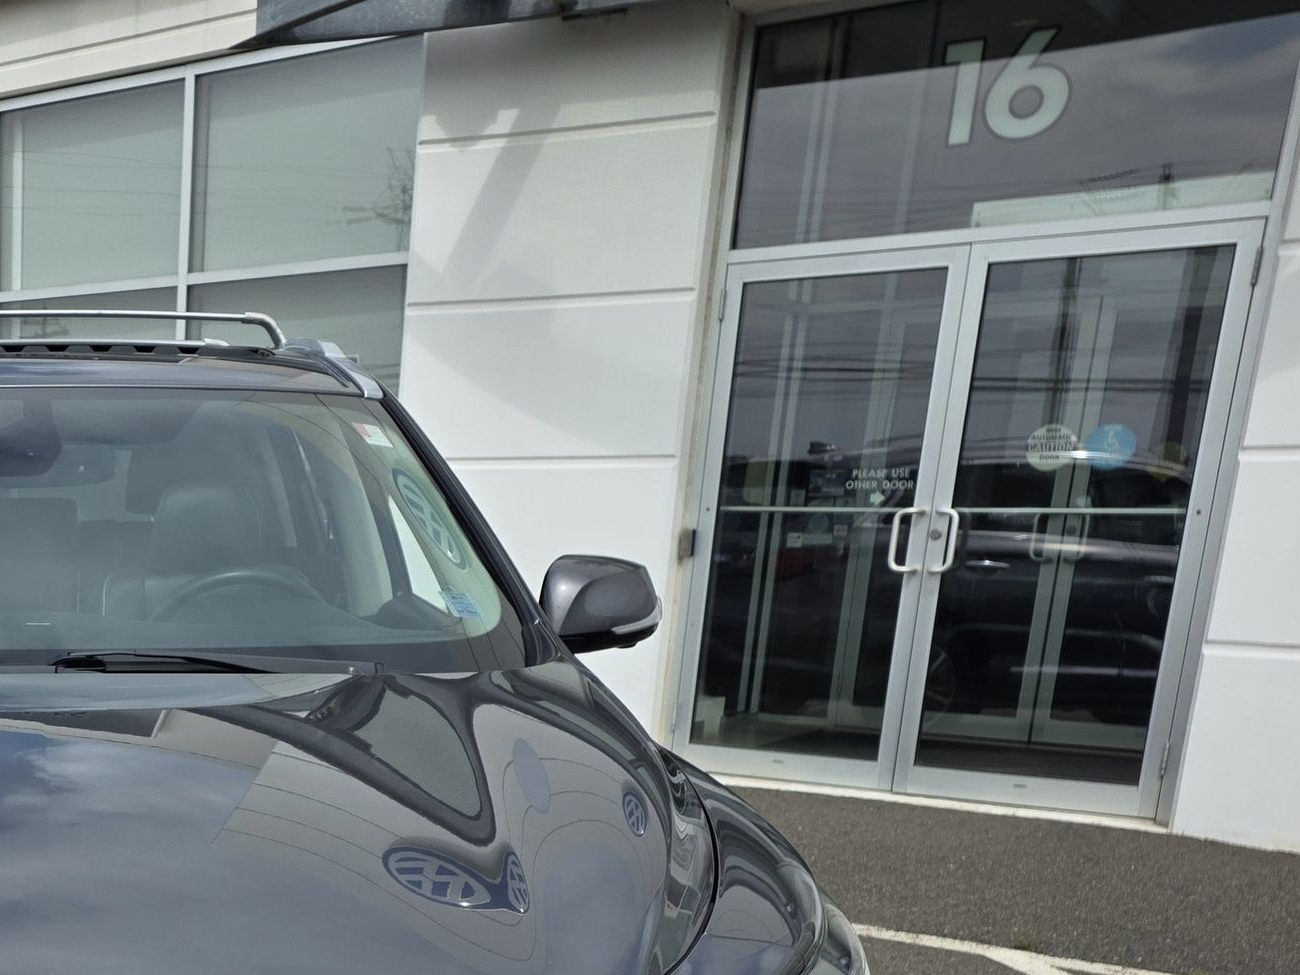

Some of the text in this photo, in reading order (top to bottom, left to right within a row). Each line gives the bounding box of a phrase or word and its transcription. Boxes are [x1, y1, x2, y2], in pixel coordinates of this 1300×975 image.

[944, 25, 1071, 146] 16
[852, 467, 911, 479] PLEASE USE
[845, 479, 915, 490] OTHER DOOR
